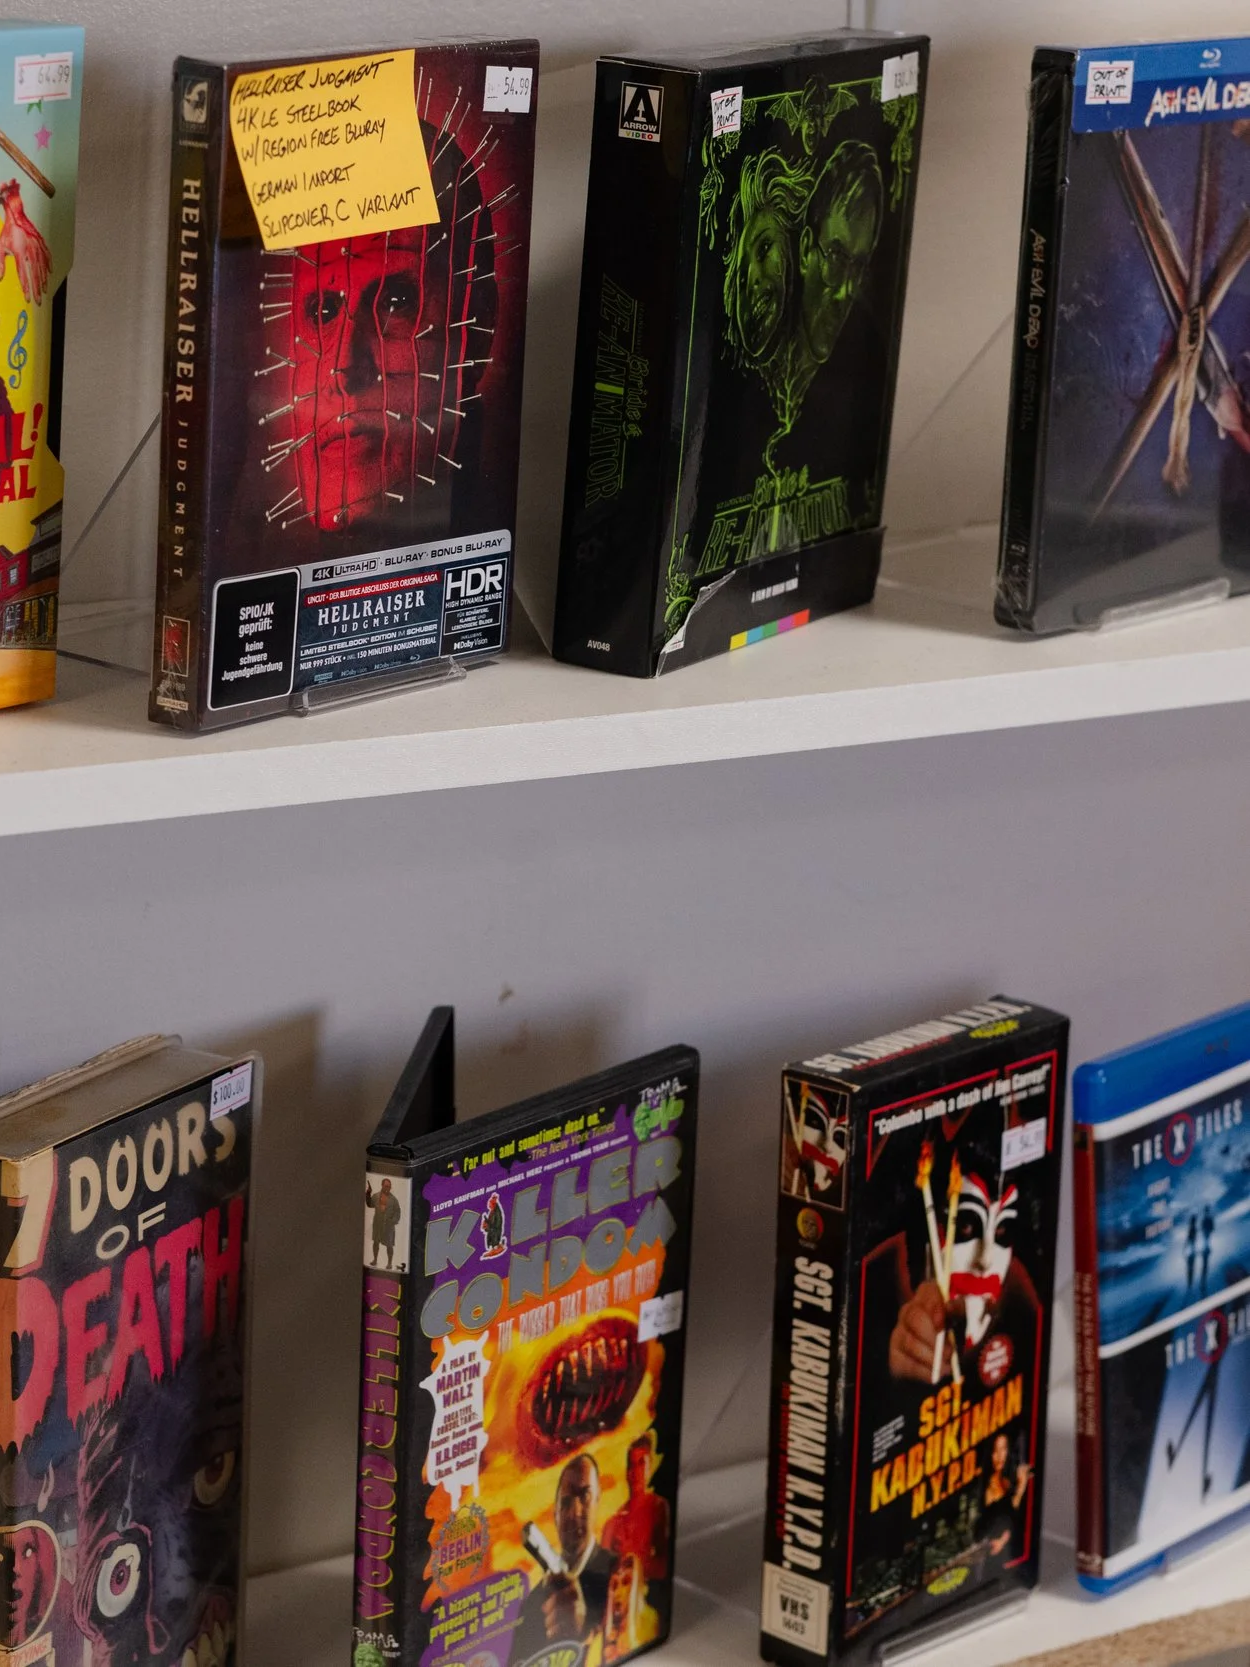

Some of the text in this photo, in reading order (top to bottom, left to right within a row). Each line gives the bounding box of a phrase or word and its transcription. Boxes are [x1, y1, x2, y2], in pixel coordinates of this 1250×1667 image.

[309, 58, 395, 89] JUDGMENT
[503, 76, 530, 96] 54.99
[1093, 69, 1115, 82] OUT
[1094, 84, 1127, 98] PRINT
[1185, 77, 1221, 114] EVIL
[261, 108, 280, 128] LE
[622, 121, 658, 133] ARROW
[262, 137, 308, 161] REGION
[311, 126, 340, 146] FREE
[625, 131, 654, 141] VIDEO
[302, 163, 356, 191] IMPORT
[335, 187, 421, 221] C VARIANT
[173, 178, 201, 578] HELLRAISER JUDGMENT
[586, 273, 636, 508] RE-ANIMATOR
[314, 545, 463, 580] 4K BONUS
[445, 563, 503, 601] HDR
[239, 602, 275, 620] SPIO/JK
[307, 596, 326, 605] UNCUT
[317, 590, 426, 626] HELLRAISER
[445, 591, 503, 609] HIGH DYNAMIC RANGE
[238, 617, 273, 638] geprüft:
[332, 611, 410, 636] JUDGMENT
[370, 631, 397, 643] EDITION
[406, 624, 438, 636] SCHUBER
[239, 652, 268, 666] schwere
[245, 641, 264, 653] keine
[299, 661, 312, 671] NUR
[313, 659, 323, 667] 999
[357, 651, 368, 659] 150
[368, 645, 393, 657] MINUTEN
[587, 639, 611, 652] AV048
[221, 661, 284, 682] Jugendgefährdung
[638, 1077, 687, 1102] TROMA
[924, 1099, 947, 1121] with
[948, 1098, 956, 1113] a
[957, 1087, 981, 1110] dash
[982, 1083, 995, 1101] of
[499, 1140, 515, 1159] and
[518, 1126, 562, 1152] sometimes
[564, 1116, 585, 1135] dead
[1132, 1098, 1243, 1169] THE X FILES
[1, 1102, 237, 1275] 7 DOORS
[432, 1197, 453, 1212] LLOYD
[453, 1187, 486, 1205] KAUFMAN
[497, 1173, 525, 1189] MICHAEL
[526, 1166, 542, 1178] HERZ
[96, 1201, 166, 1260] OF
[420, 1196, 678, 1339] CONDOM
[793, 1256, 834, 1313] SGT.
[1164, 1319, 1220, 1370] THE X
[436, 1362, 481, 1394] MARTIN
[441, 1351, 477, 1373] A FILM BY
[442, 1382, 473, 1409] WALZ
[786, 1316, 832, 1477] KABUKIMAN
[918, 1380, 971, 1439] SGT.
[357, 1283, 401, 1620] KILLER CONDOM
[870, 1373, 1023, 1514] KABUKIMAN
[911, 1450, 983, 1520] N.Y.P.D.
[782, 1474, 825, 1571] N.Y.P.D.
[439, 1533, 482, 1565] BERLIN
[780, 1593, 809, 1621] VHS
